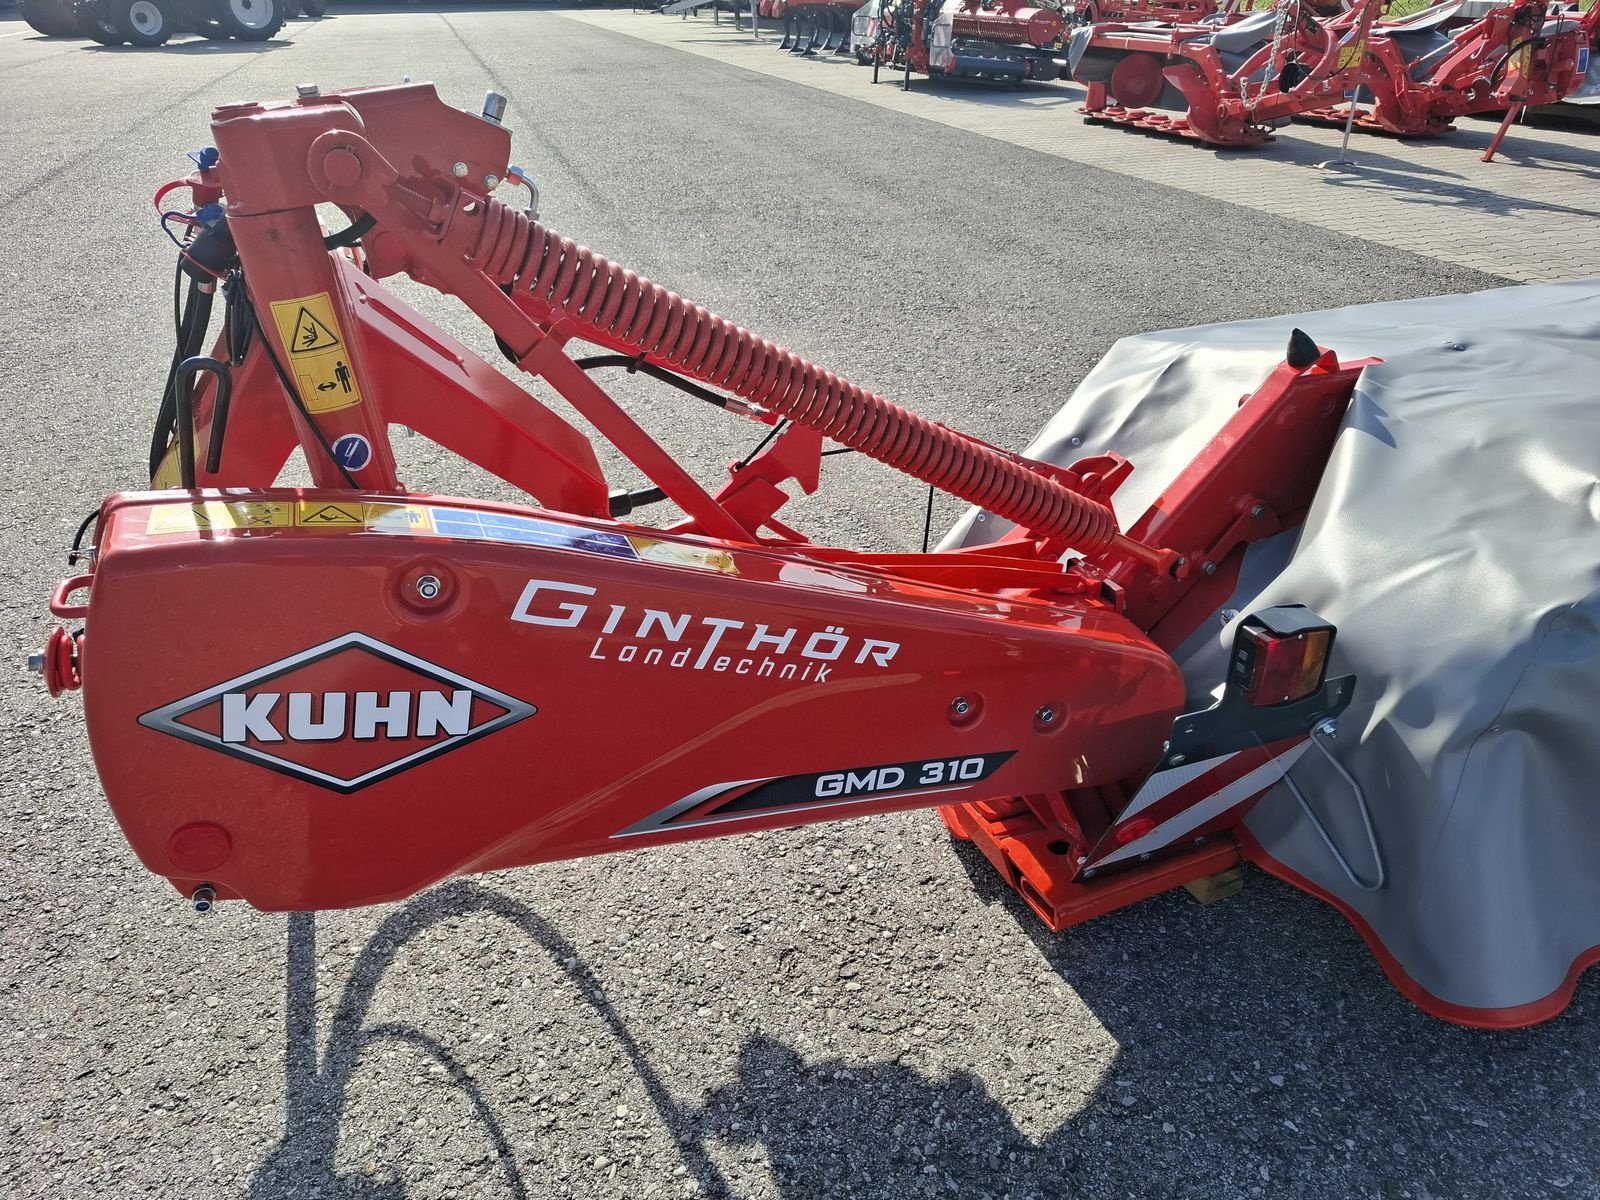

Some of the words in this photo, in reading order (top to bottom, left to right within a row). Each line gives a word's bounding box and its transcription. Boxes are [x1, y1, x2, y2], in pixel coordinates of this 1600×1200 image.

[510, 578, 901, 670] GINTHÖR
[223, 690, 472, 742] KUHN
[815, 767, 905, 797] GMD
[919, 757, 985, 785] 310
